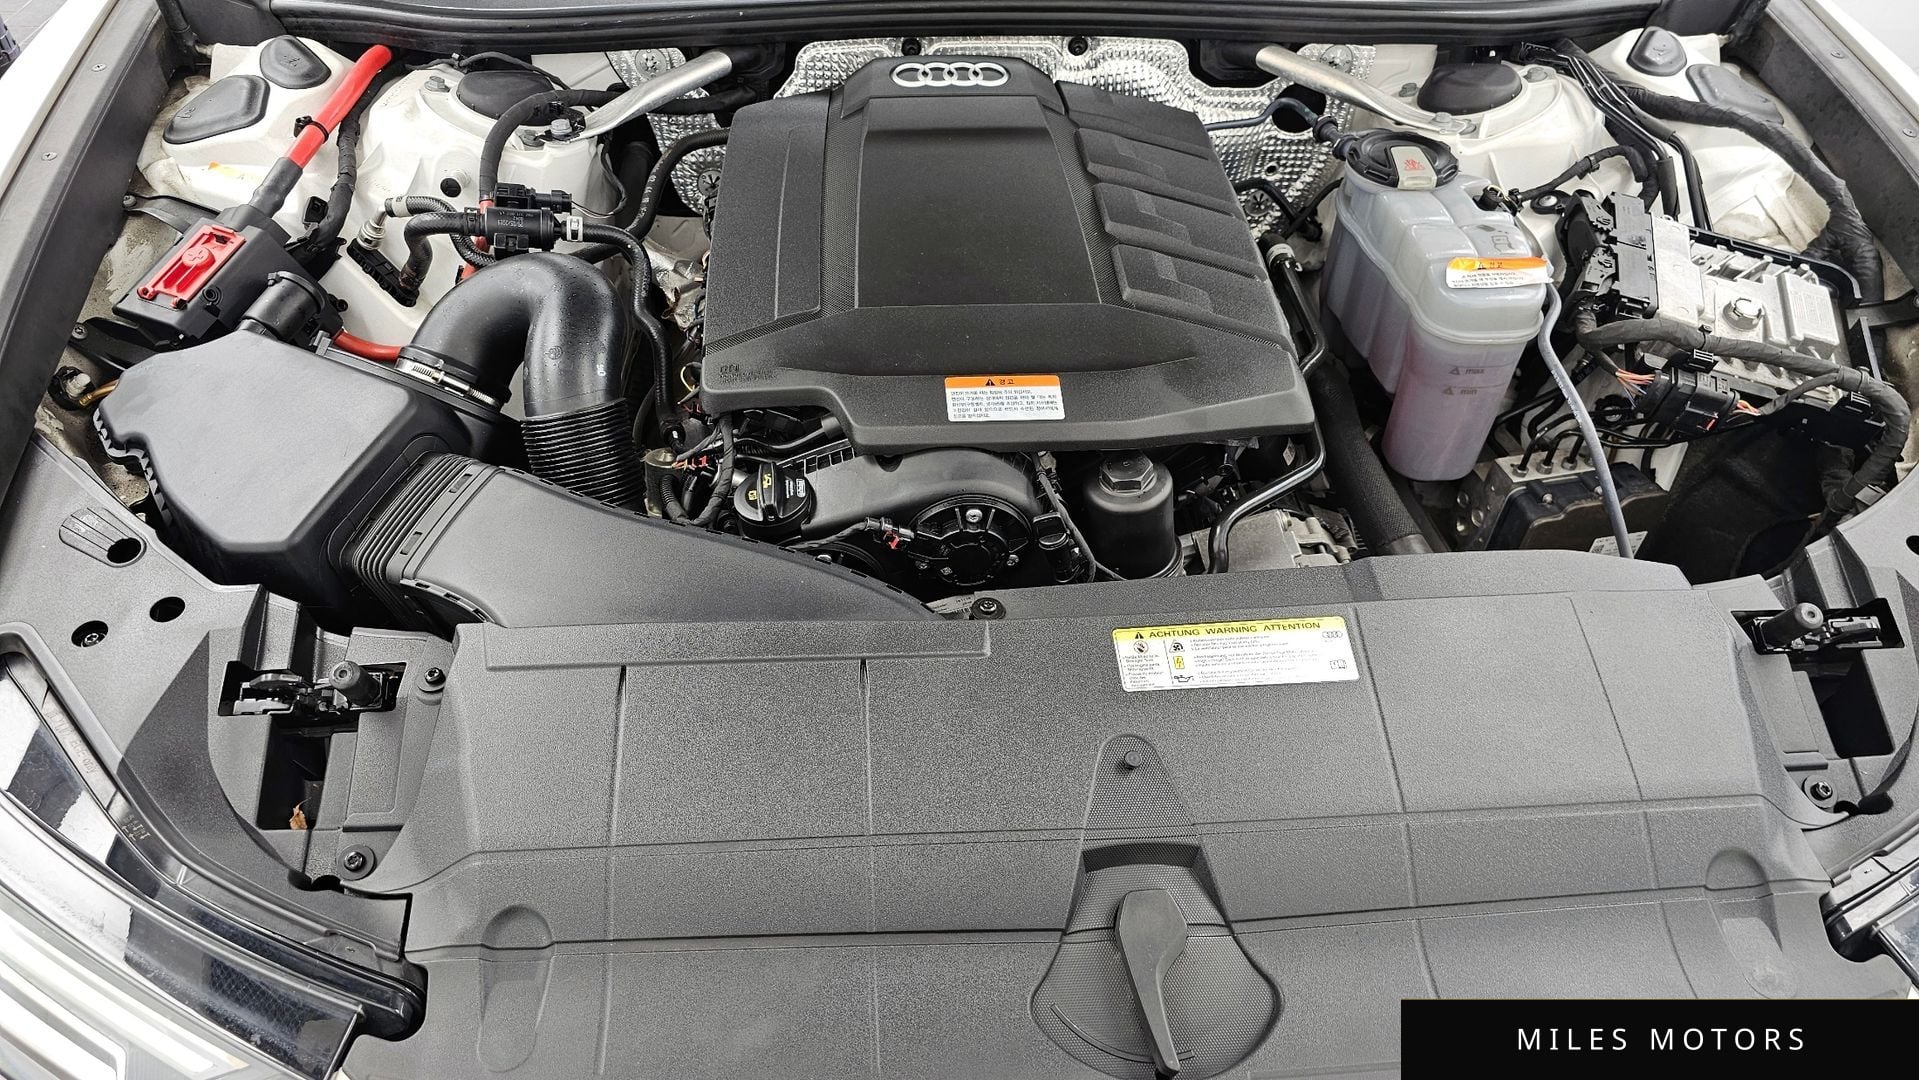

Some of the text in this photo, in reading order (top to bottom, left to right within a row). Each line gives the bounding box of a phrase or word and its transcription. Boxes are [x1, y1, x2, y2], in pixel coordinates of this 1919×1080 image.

[1149, 622, 1321, 638] ACHTUNG WARNING ATTENTION
